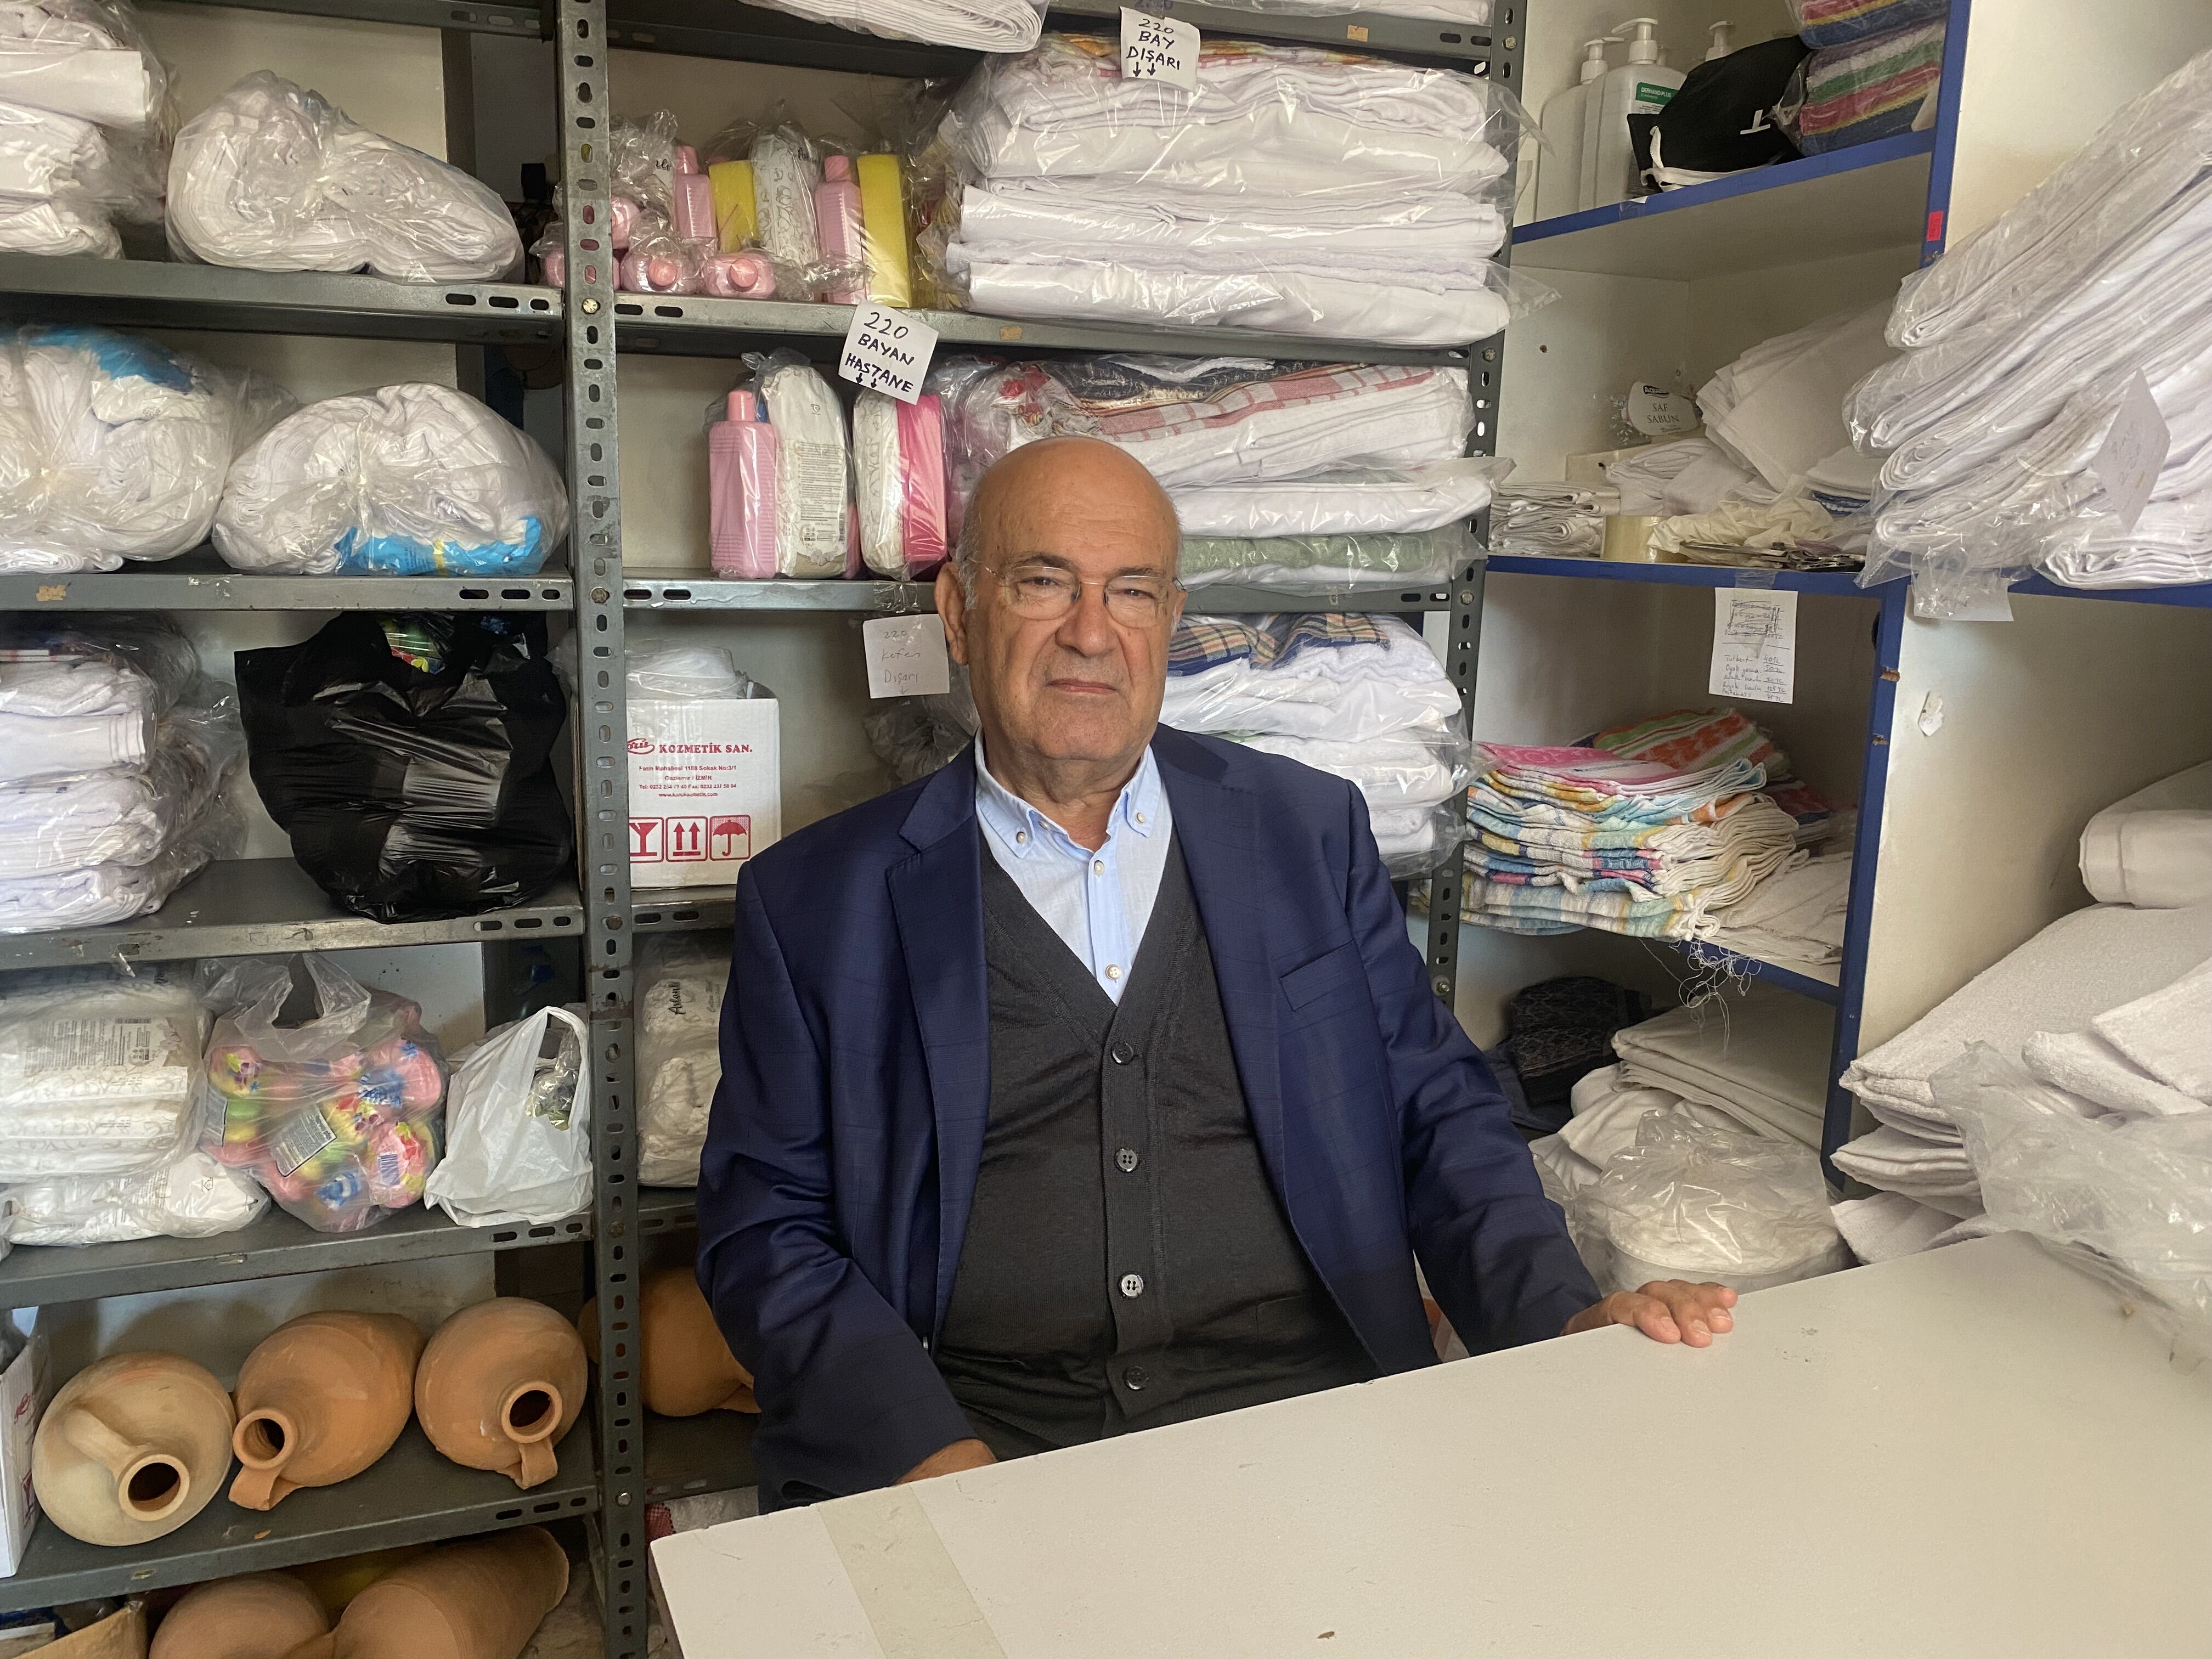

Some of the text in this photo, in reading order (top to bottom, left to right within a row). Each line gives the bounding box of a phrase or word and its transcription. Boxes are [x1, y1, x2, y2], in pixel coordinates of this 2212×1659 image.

[1138, 18, 1174, 33] 220
[1138, 31, 1175, 49] BAY
[1126, 46, 1180, 70] DIŞARI
[864, 312, 909, 339] 220
[857, 333, 915, 366] BAYAN
[845, 353, 913, 393] HASTANE
[1647, 415, 1680, 424] SABUN
[884, 630, 907, 639] 220
[659, 742, 721, 753] KOZMETİK
[725, 744, 753, 753] SAN.
